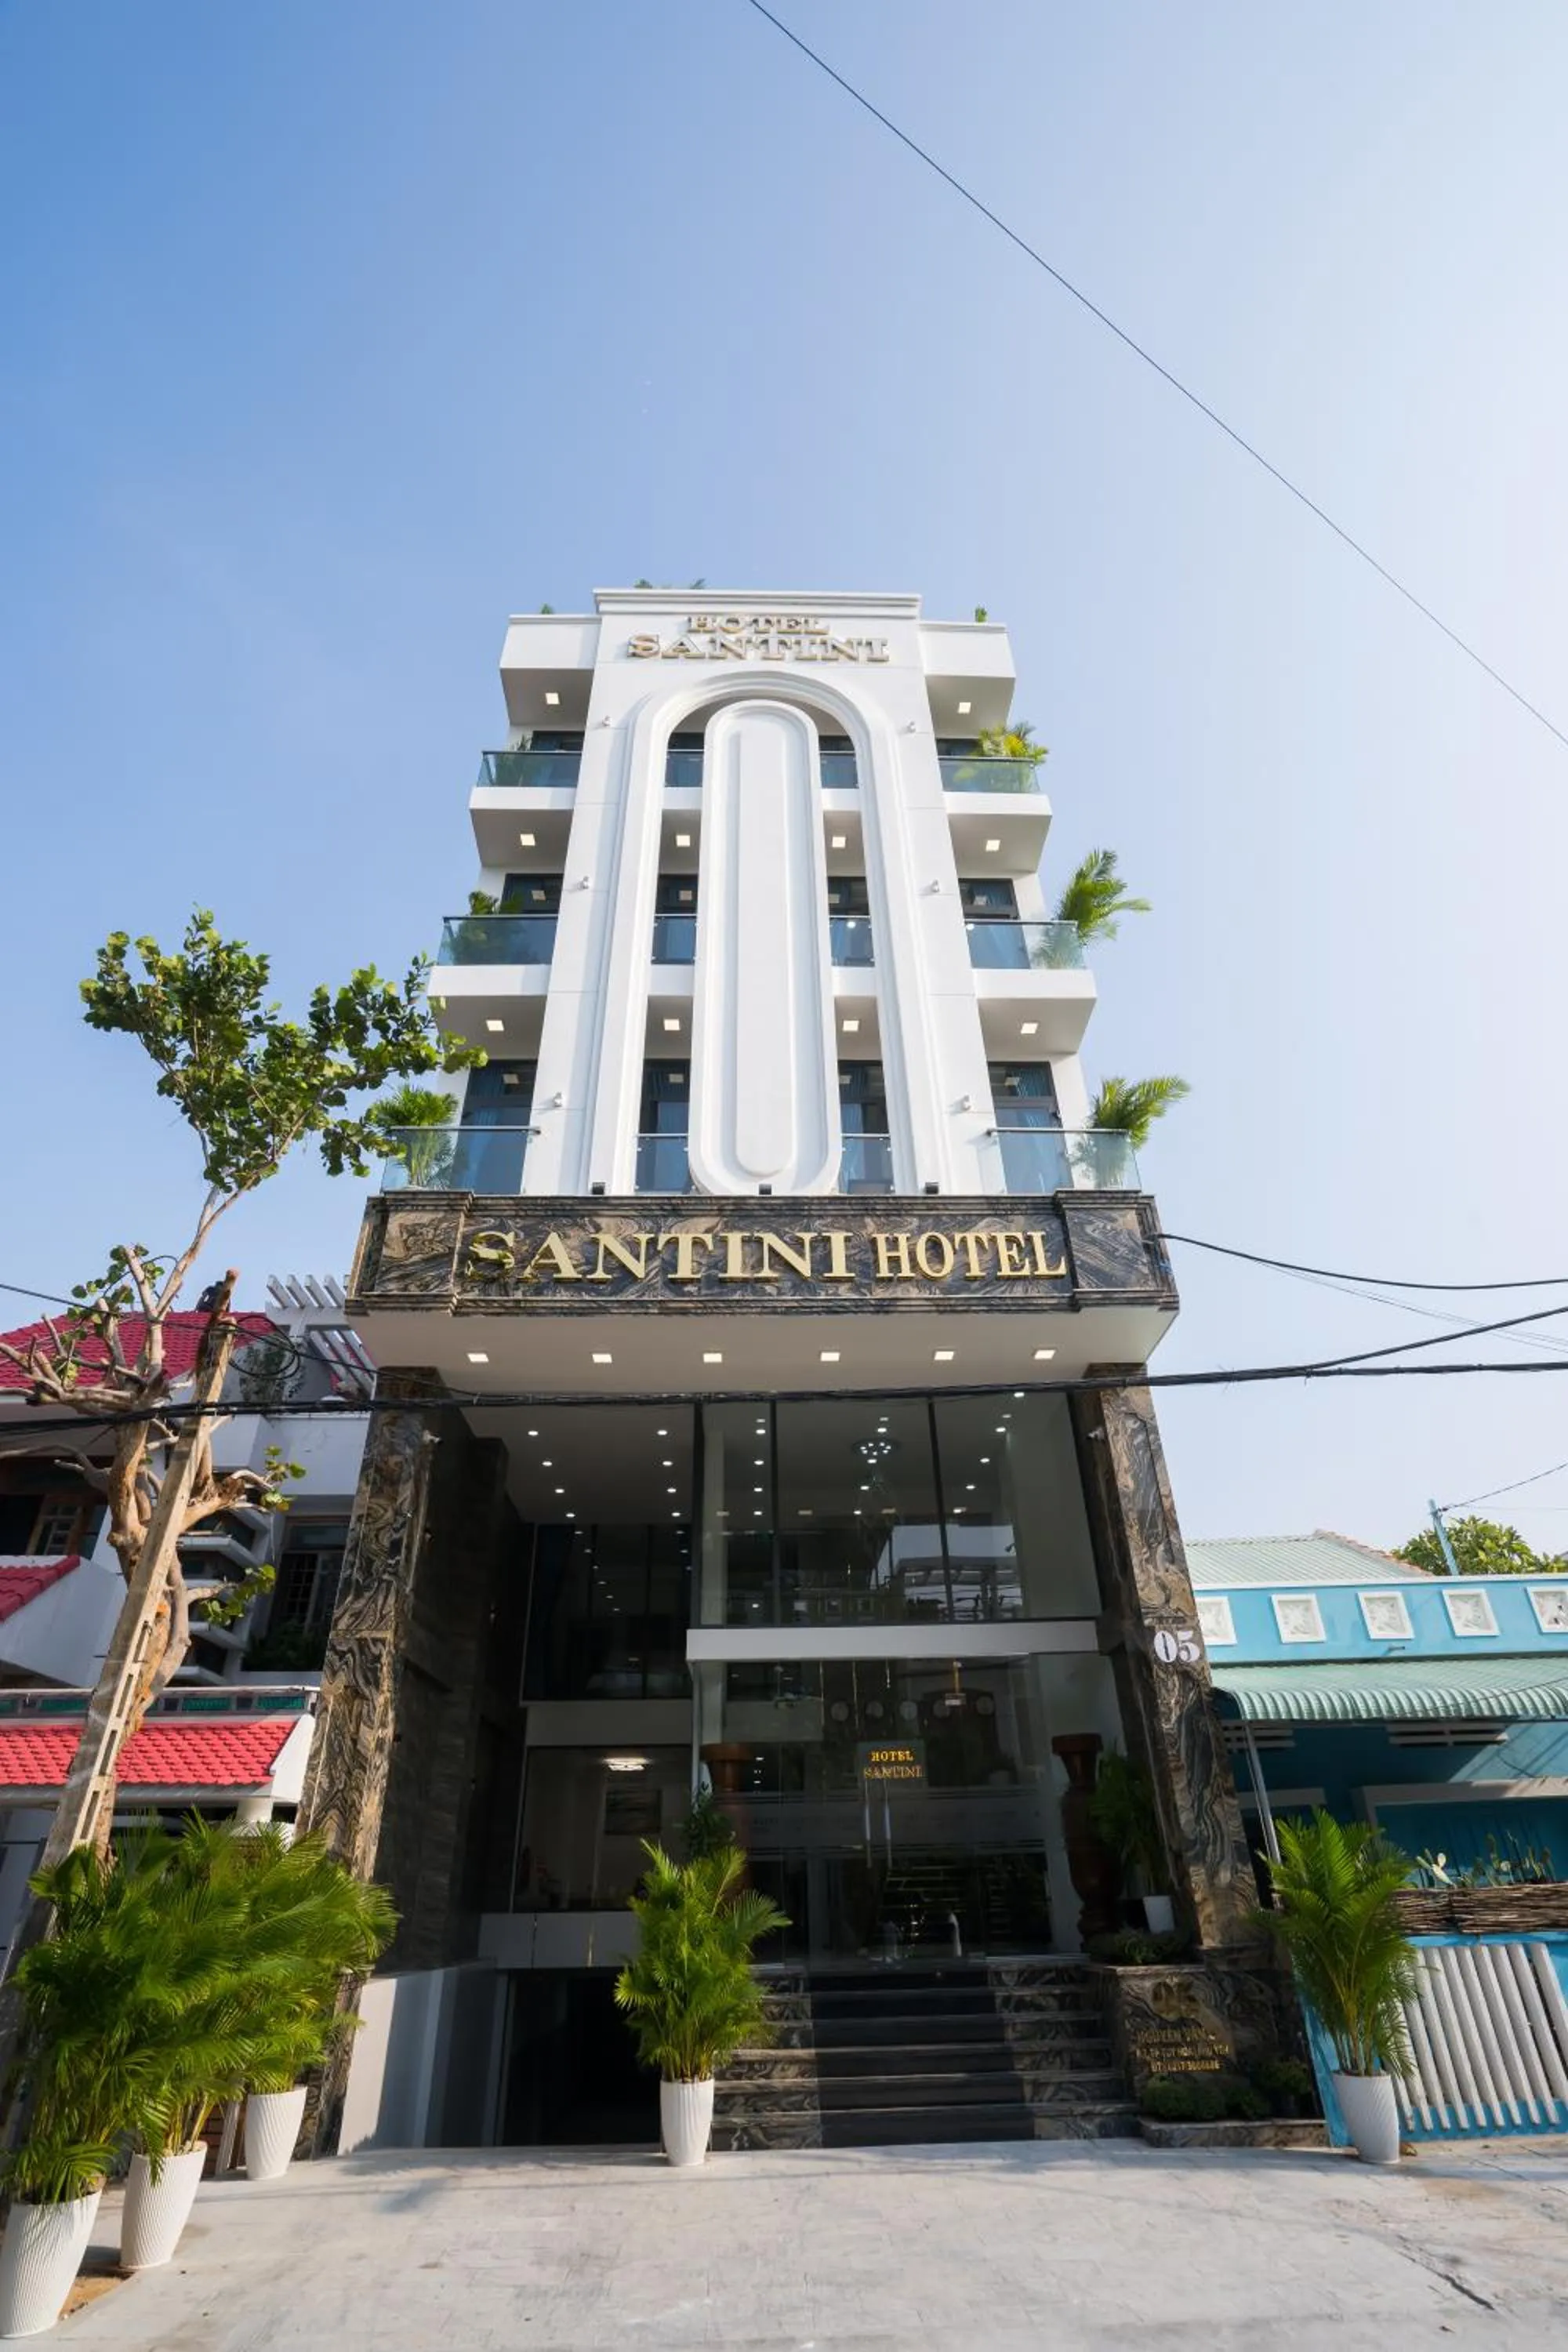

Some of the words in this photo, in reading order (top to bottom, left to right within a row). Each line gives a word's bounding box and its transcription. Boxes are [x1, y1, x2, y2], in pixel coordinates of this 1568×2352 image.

[687, 615, 829, 634] HOTEL
[627, 633, 890, 662] SANTINI
[465, 1229, 855, 1282] SANTINI
[872, 1230, 1067, 1280] HOTEL
[1154, 1630, 1200, 1662] 05
[871, 1750, 915, 1762] HOTEL
